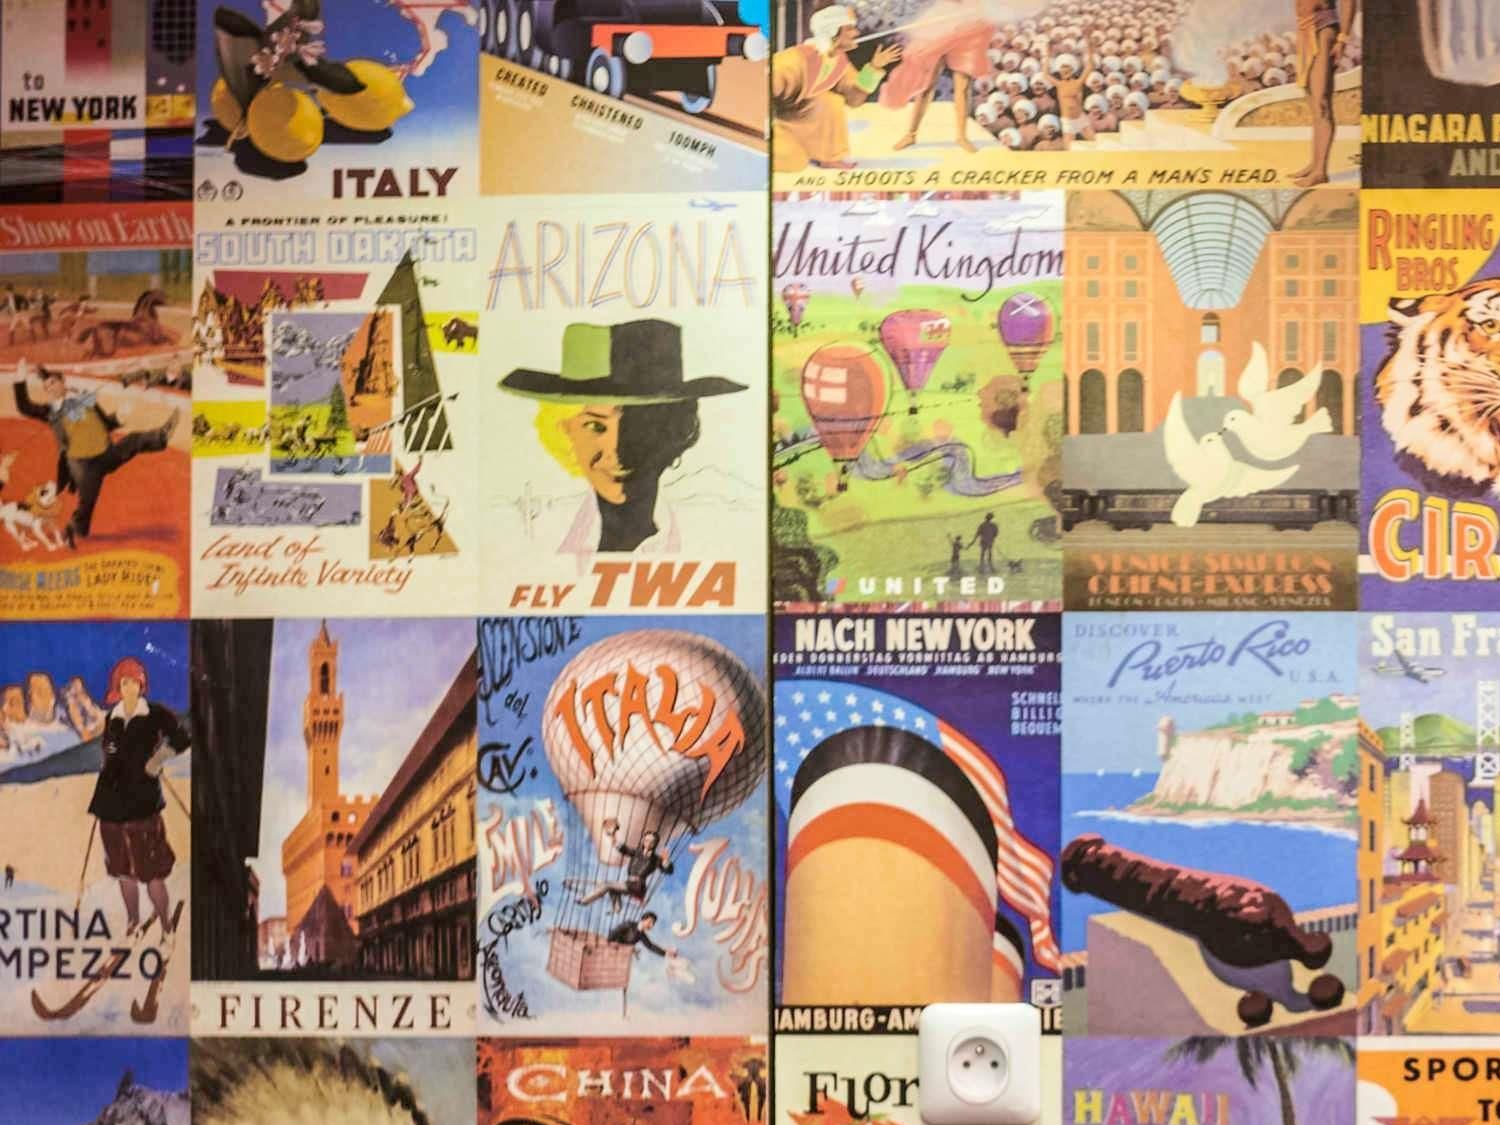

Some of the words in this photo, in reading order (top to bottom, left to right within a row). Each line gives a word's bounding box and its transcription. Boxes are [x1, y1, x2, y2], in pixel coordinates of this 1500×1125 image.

[23, 72, 45, 90] to
[9, 95, 67, 122] NEW
[72, 94, 137, 120] YORK
[570, 94, 645, 131] CHRISTENED
[1362, 113, 1486, 144] NIAGARA
[332, 168, 459, 199] ITALY
[796, 174, 825, 187] AND
[834, 169, 915, 186] SHOOTS
[926, 169, 941, 185] A
[951, 169, 1047, 185] CRACKER
[1056, 169, 1113, 185] FROM
[1123, 168, 1138, 185] A
[240, 217, 321, 226] FRONTIER
[1367, 208, 1494, 270] RINGLING
[196, 230, 316, 266] SOUTH
[327, 227, 478, 265] DAKOTA
[772, 221, 908, 279] United
[915, 220, 1065, 303] Kingdom
[486, 220, 757, 311] ARIZONA
[1395, 256, 1459, 292] BROS
[201, 535, 276, 561] Land
[206, 561, 309, 597] Infinite
[315, 559, 414, 594] Variety
[509, 583, 575, 609] FLY
[590, 560, 738, 609] TWA
[859, 576, 1006, 595] UNITED
[795, 617, 876, 651] NACH
[1074, 623, 1180, 638] DISCOVER
[1371, 615, 1442, 656] San
[1107, 637, 1228, 689] Puerto
[1227, 619, 1311, 676] Rico
[219, 994, 450, 1030] FIRENZE
[507, 1062, 731, 1102] CHINA
